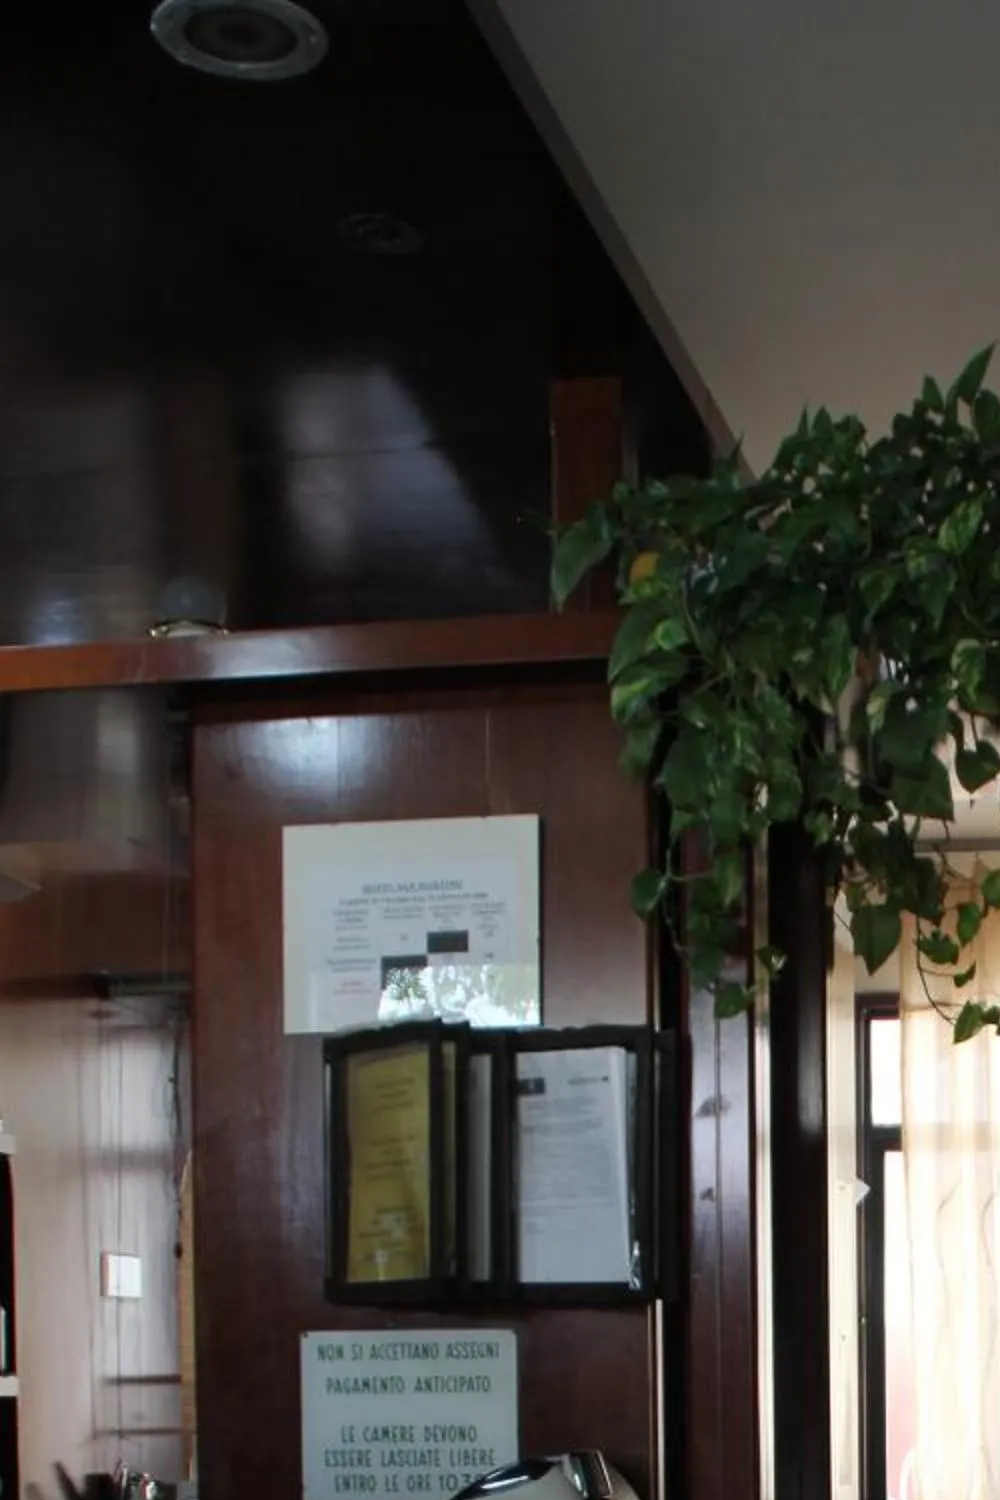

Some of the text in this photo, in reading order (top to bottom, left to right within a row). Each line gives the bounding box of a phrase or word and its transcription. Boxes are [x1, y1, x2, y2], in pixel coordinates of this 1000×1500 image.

[317, 1341, 500, 1361] NON SI ACCETTANO ASSEGNI
[326, 1375, 491, 1395] PAGAMENTO ANTICIPATO
[341, 1424, 477, 1443] LE CAMERE DEVONO
[324, 1448, 495, 1468] ESSERE LASCIATE LIBERE
[335, 1474, 377, 1493] ENTRO
[384, 1474, 399, 1493] LE
[406, 1474, 432, 1493] ORE
